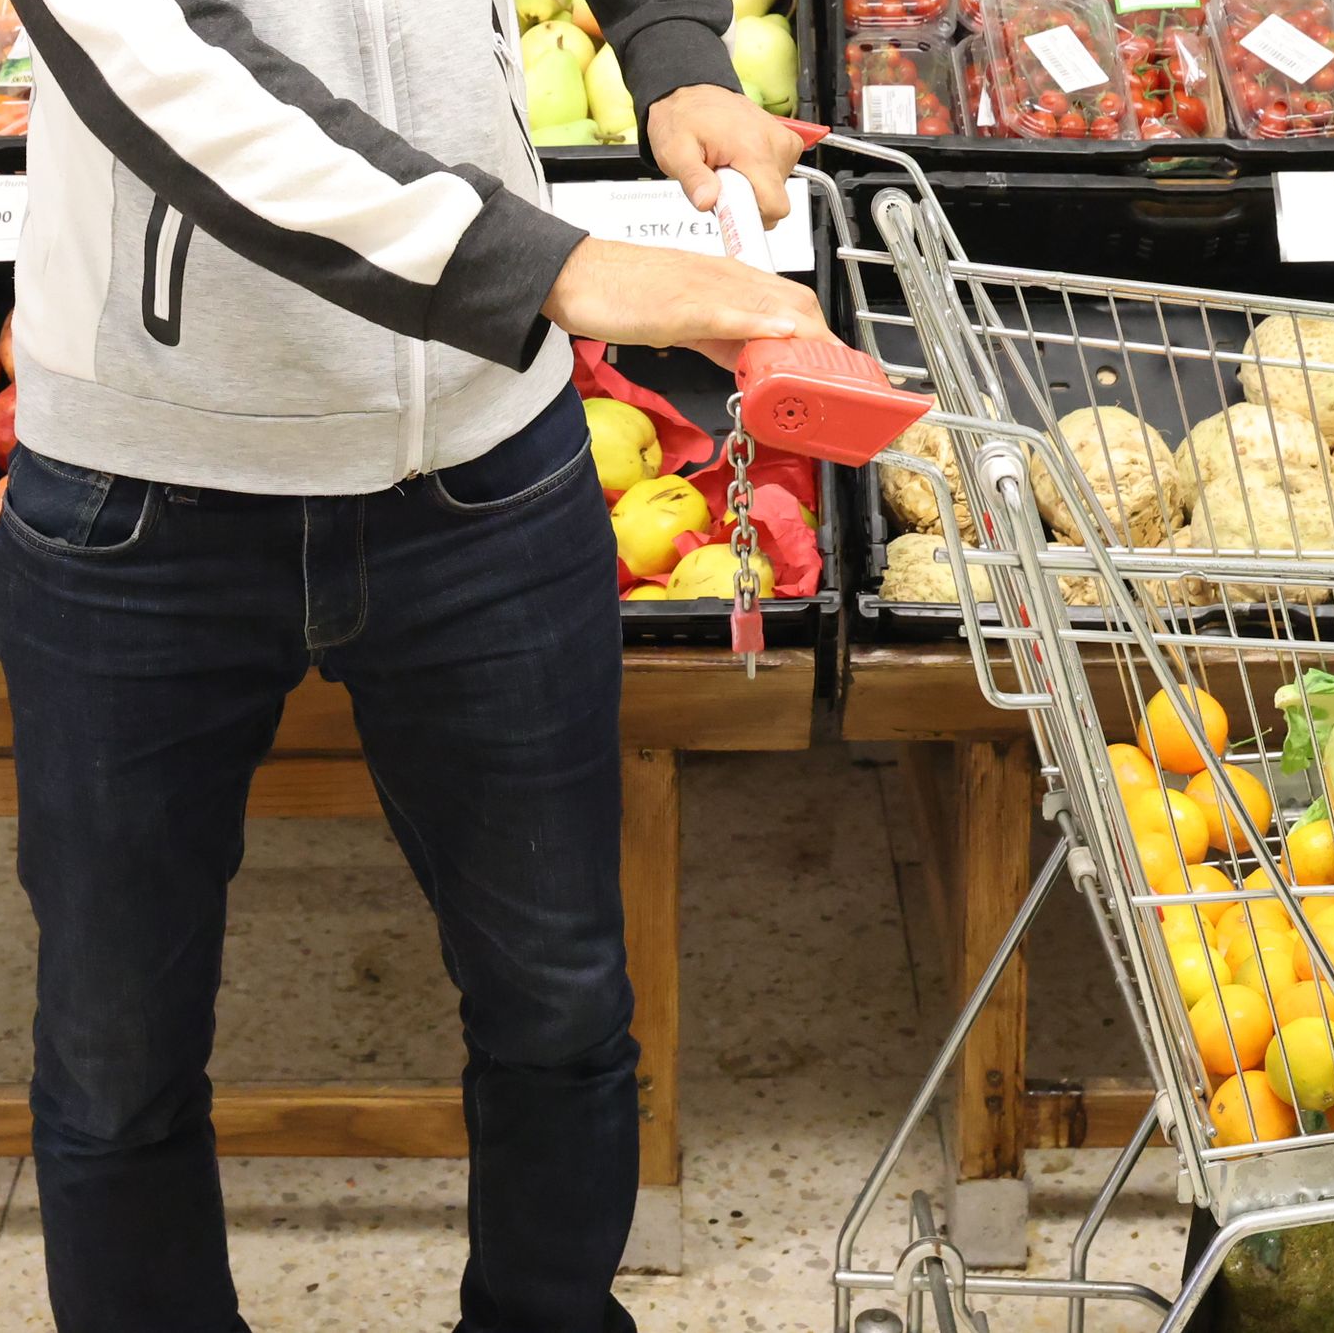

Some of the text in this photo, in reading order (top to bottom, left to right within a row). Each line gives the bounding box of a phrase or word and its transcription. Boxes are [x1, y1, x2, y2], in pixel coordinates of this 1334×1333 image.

[610, 190, 673, 201] Sozialmarkt
[625, 225, 633, 238] 1
[639, 223, 670, 237] STK
[689, 222, 699, 236] €
[705, 222, 719, 237] 1,
